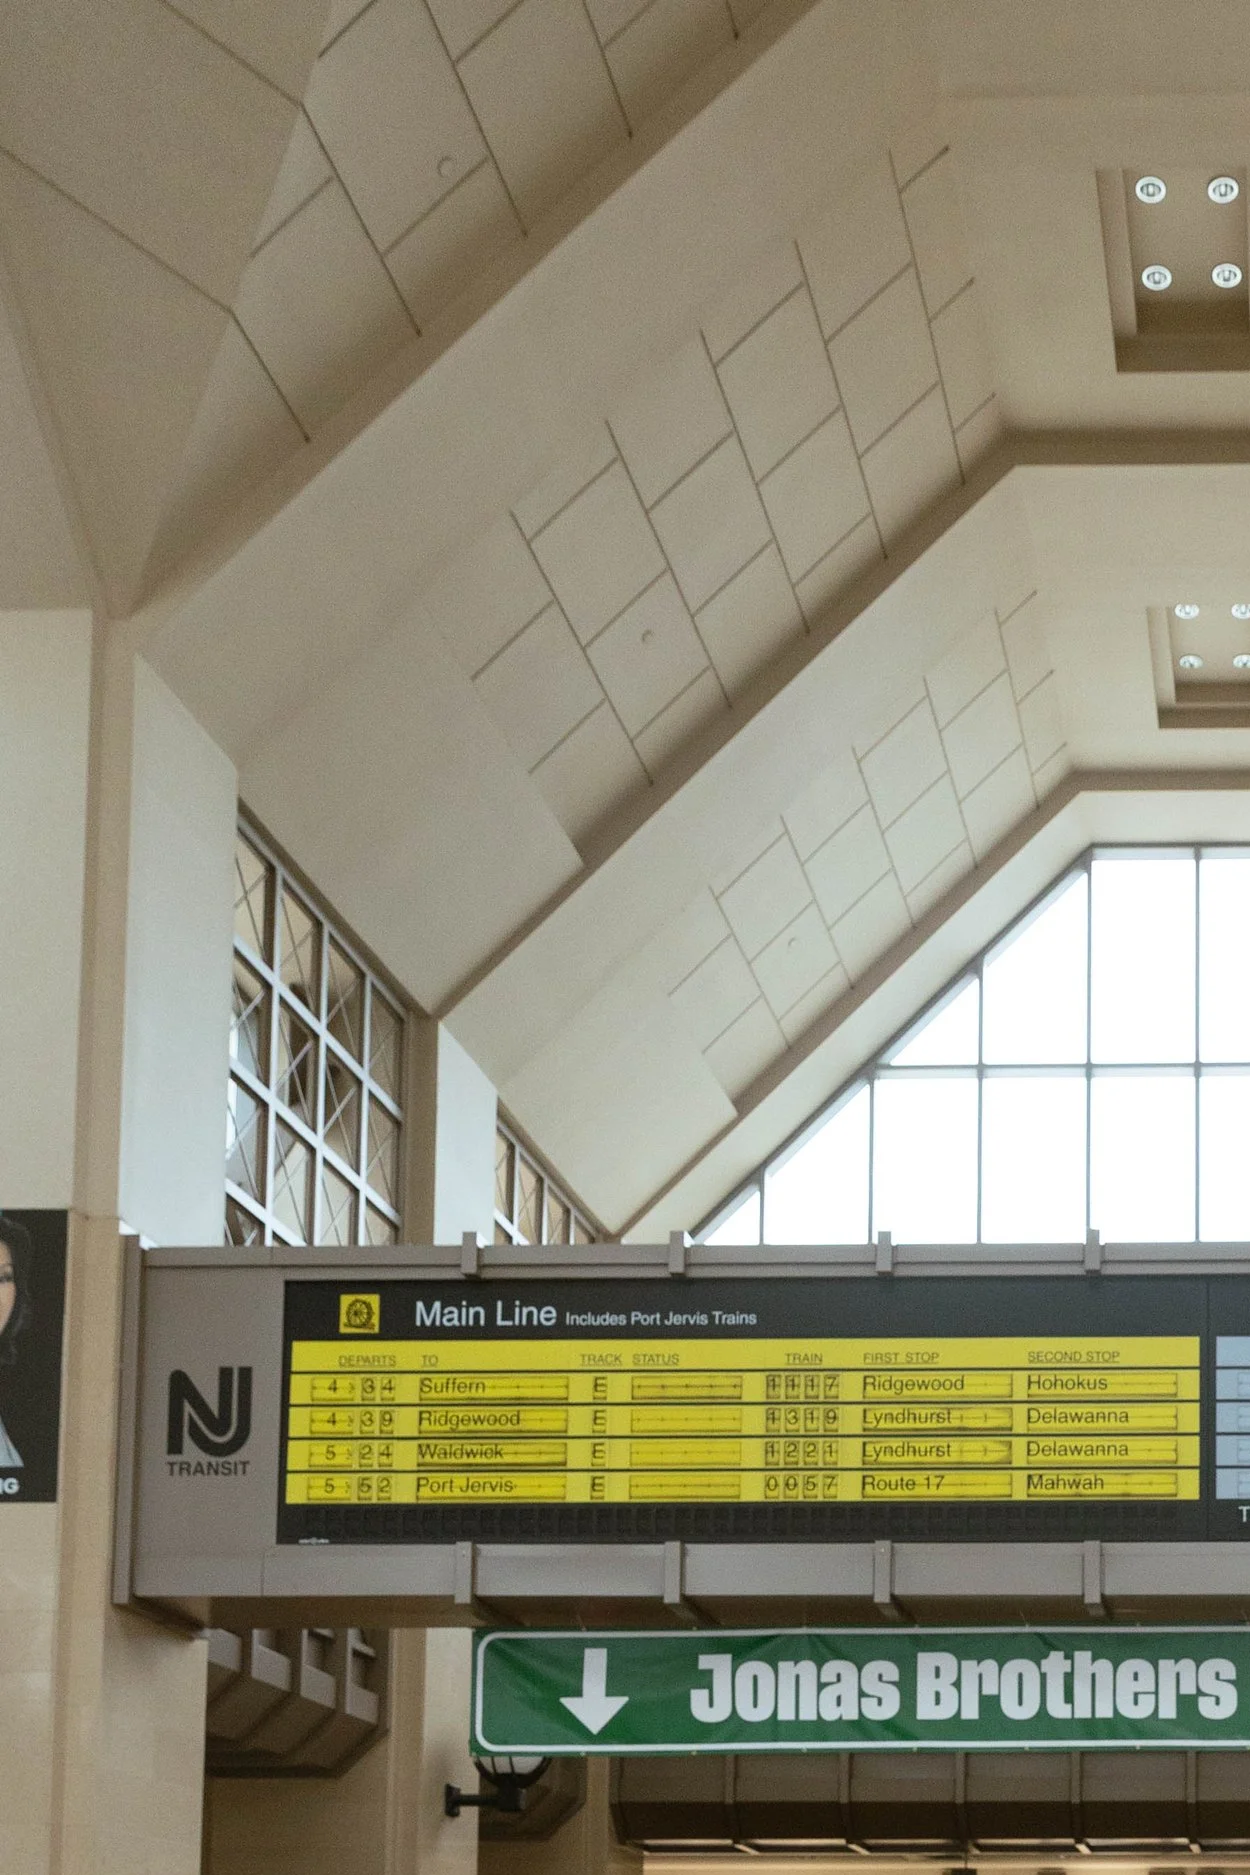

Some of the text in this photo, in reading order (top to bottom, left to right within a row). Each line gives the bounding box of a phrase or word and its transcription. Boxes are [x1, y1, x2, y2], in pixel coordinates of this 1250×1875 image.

[415, 1299, 556, 1326] Main Line
[566, 1310, 757, 1326] Includes Port Jervis Trains
[338, 1355, 438, 1366] DEPARTS TO
[580, 1353, 679, 1365] TRACK STATUS
[785, 1353, 823, 1364] TRAIN
[863, 1352, 939, 1364] FIRST STOP
[1028, 1351, 1120, 1362] SECOND STOP
[420, 1378, 486, 1393] Suffern
[594, 1377, 607, 1392] E
[863, 1375, 964, 1394] Ridgewood
[1028, 1375, 1108, 1390] Hohokus
[166, 1366, 252, 1457] NJ
[593, 1410, 607, 1426] E
[769, 1409, 837, 1424] 1319
[863, 1408, 952, 1427] Lyndhurst
[1028, 1408, 1129, 1424] Delawanna
[419, 1410, 520, 1430] Ridgewood
[418, 1443, 503, 1459] Waldwick
[593, 1443, 606, 1459] E
[769, 1442, 835, 1457] 1221
[863, 1441, 952, 1461] Lyndhurst
[1028, 1440, 1129, 1456] Delawanna
[166, 1461, 250, 1476] TRANSIT
[417, 1477, 513, 1493] Port Jervis
[592, 1476, 605, 1492] E
[767, 1476, 836, 1491] 0057
[862, 1475, 945, 1490] Route 17
[1028, 1474, 1104, 1490] Mahwah
[690, 1653, 900, 1723] Jonas
[917, 1650, 1237, 1720] Brothers
